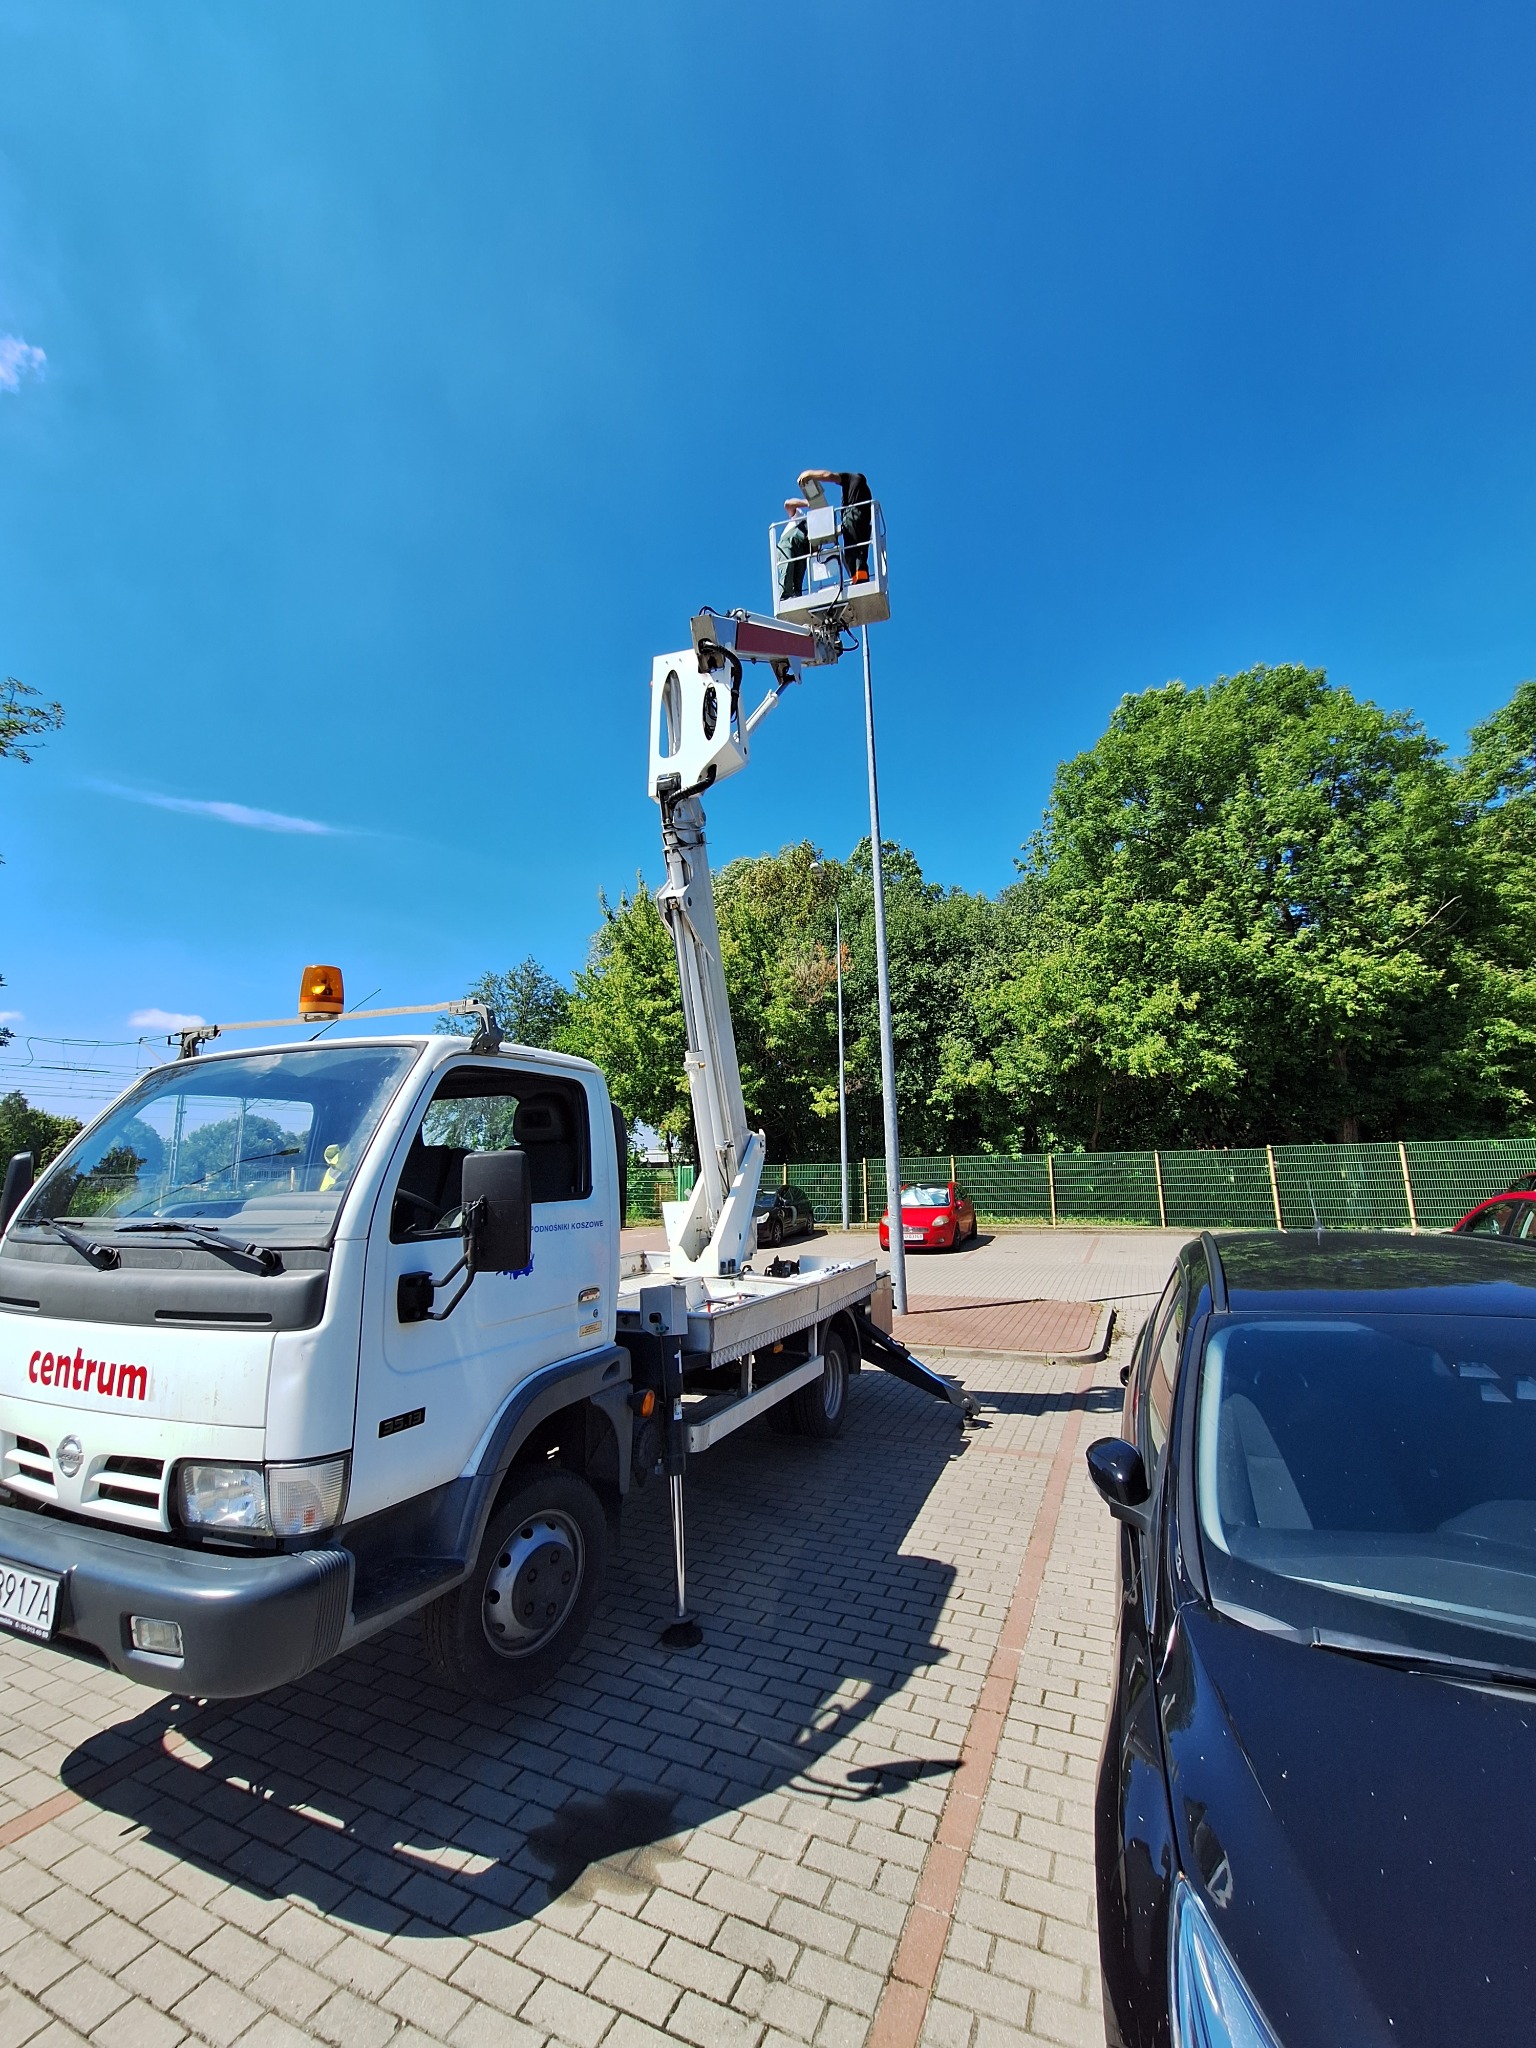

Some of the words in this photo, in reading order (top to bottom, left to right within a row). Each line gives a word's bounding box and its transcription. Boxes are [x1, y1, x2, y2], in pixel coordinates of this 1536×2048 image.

[571, 1220, 604, 1230] KOSZOWE
[29, 1347, 148, 1400] centrum
[383, 1411, 422, 1435] 35.13
